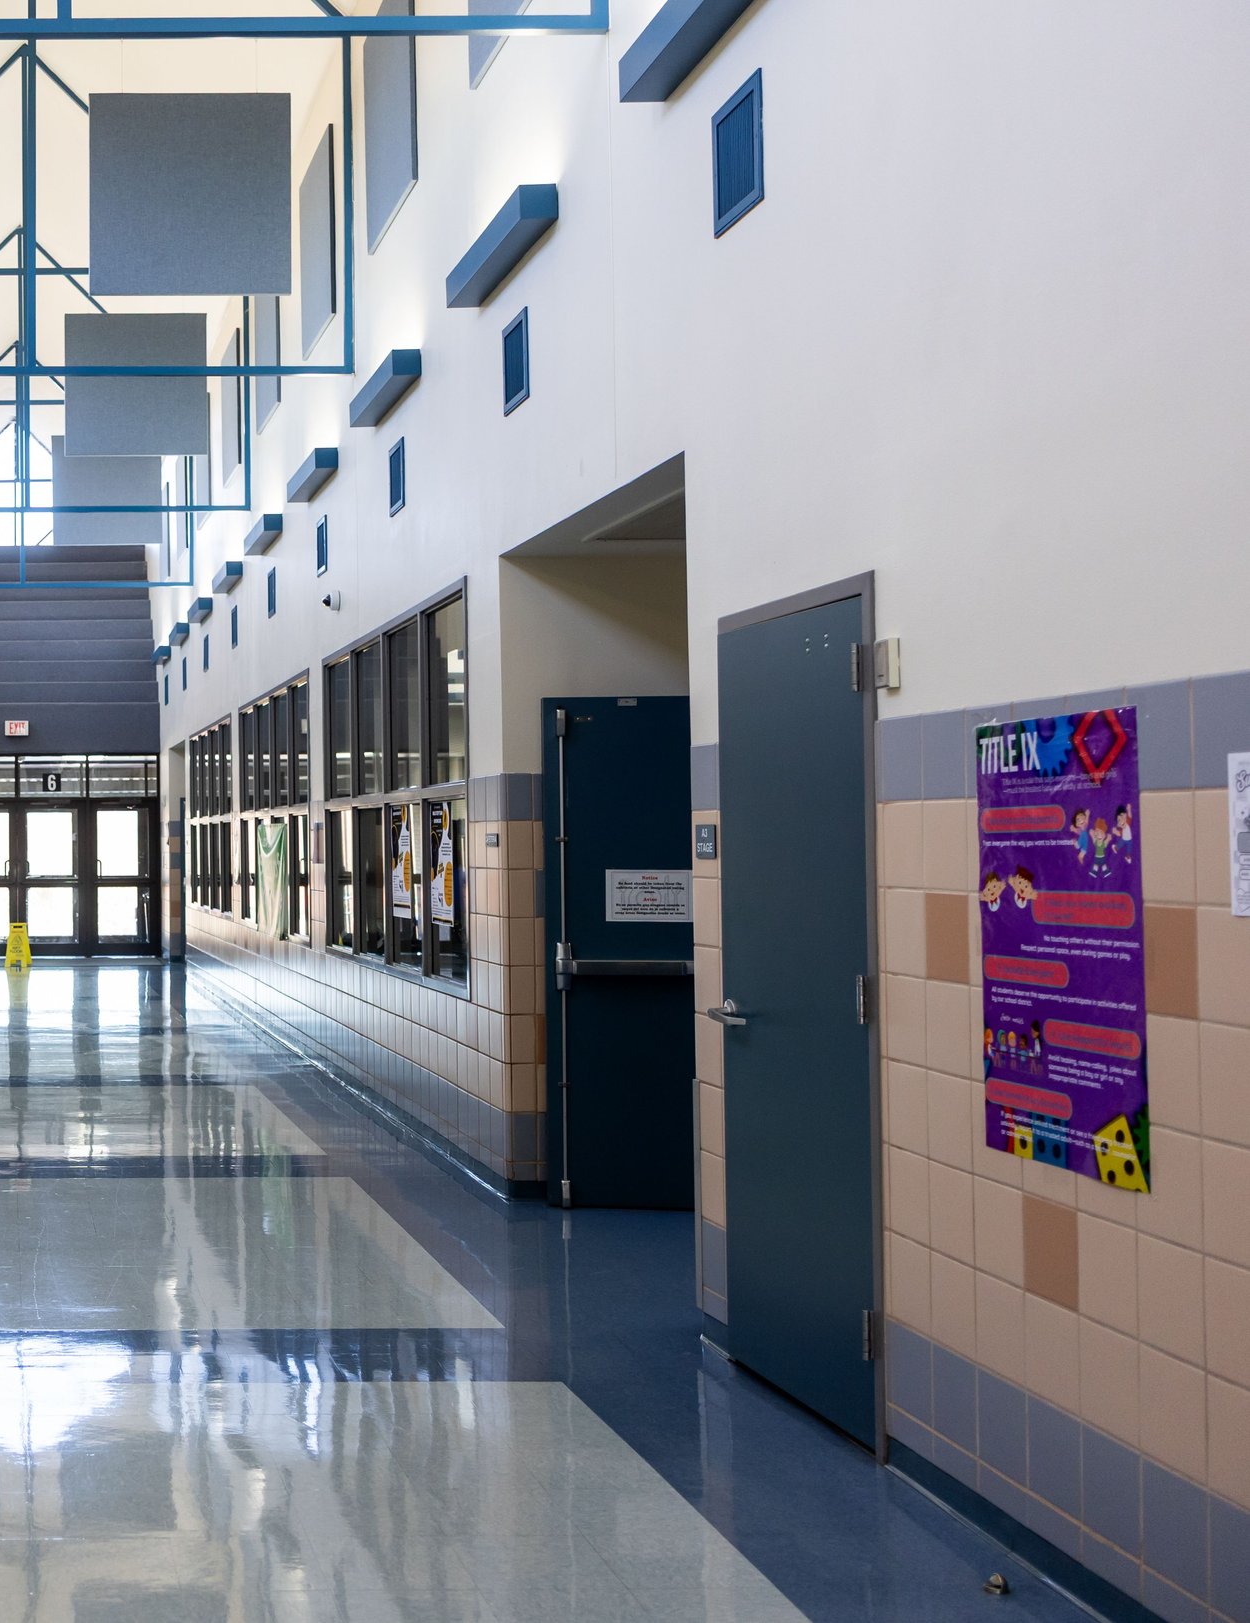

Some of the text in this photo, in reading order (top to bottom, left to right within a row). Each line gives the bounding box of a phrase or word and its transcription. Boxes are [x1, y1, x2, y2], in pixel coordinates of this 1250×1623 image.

[9, 722, 25, 734] EXIT
[980, 732, 1041, 775] TITLE IX
[48, 774, 57, 791] 6
[697, 843, 713, 852] STAGE
[1051, 936, 1069, 944] touching
[1082, 950, 1096, 958] during
[1038, 993, 1062, 1002] opportunity
[1098, 1000, 1117, 1008] activities
[1118, 1003, 1136, 1011] offered
[1068, 1068, 1080, 1076] being
[1085, 1070, 1093, 1079] boy
[1109, 1064, 1122, 1073] jokes
[1122, 1068, 1137, 1076] about
